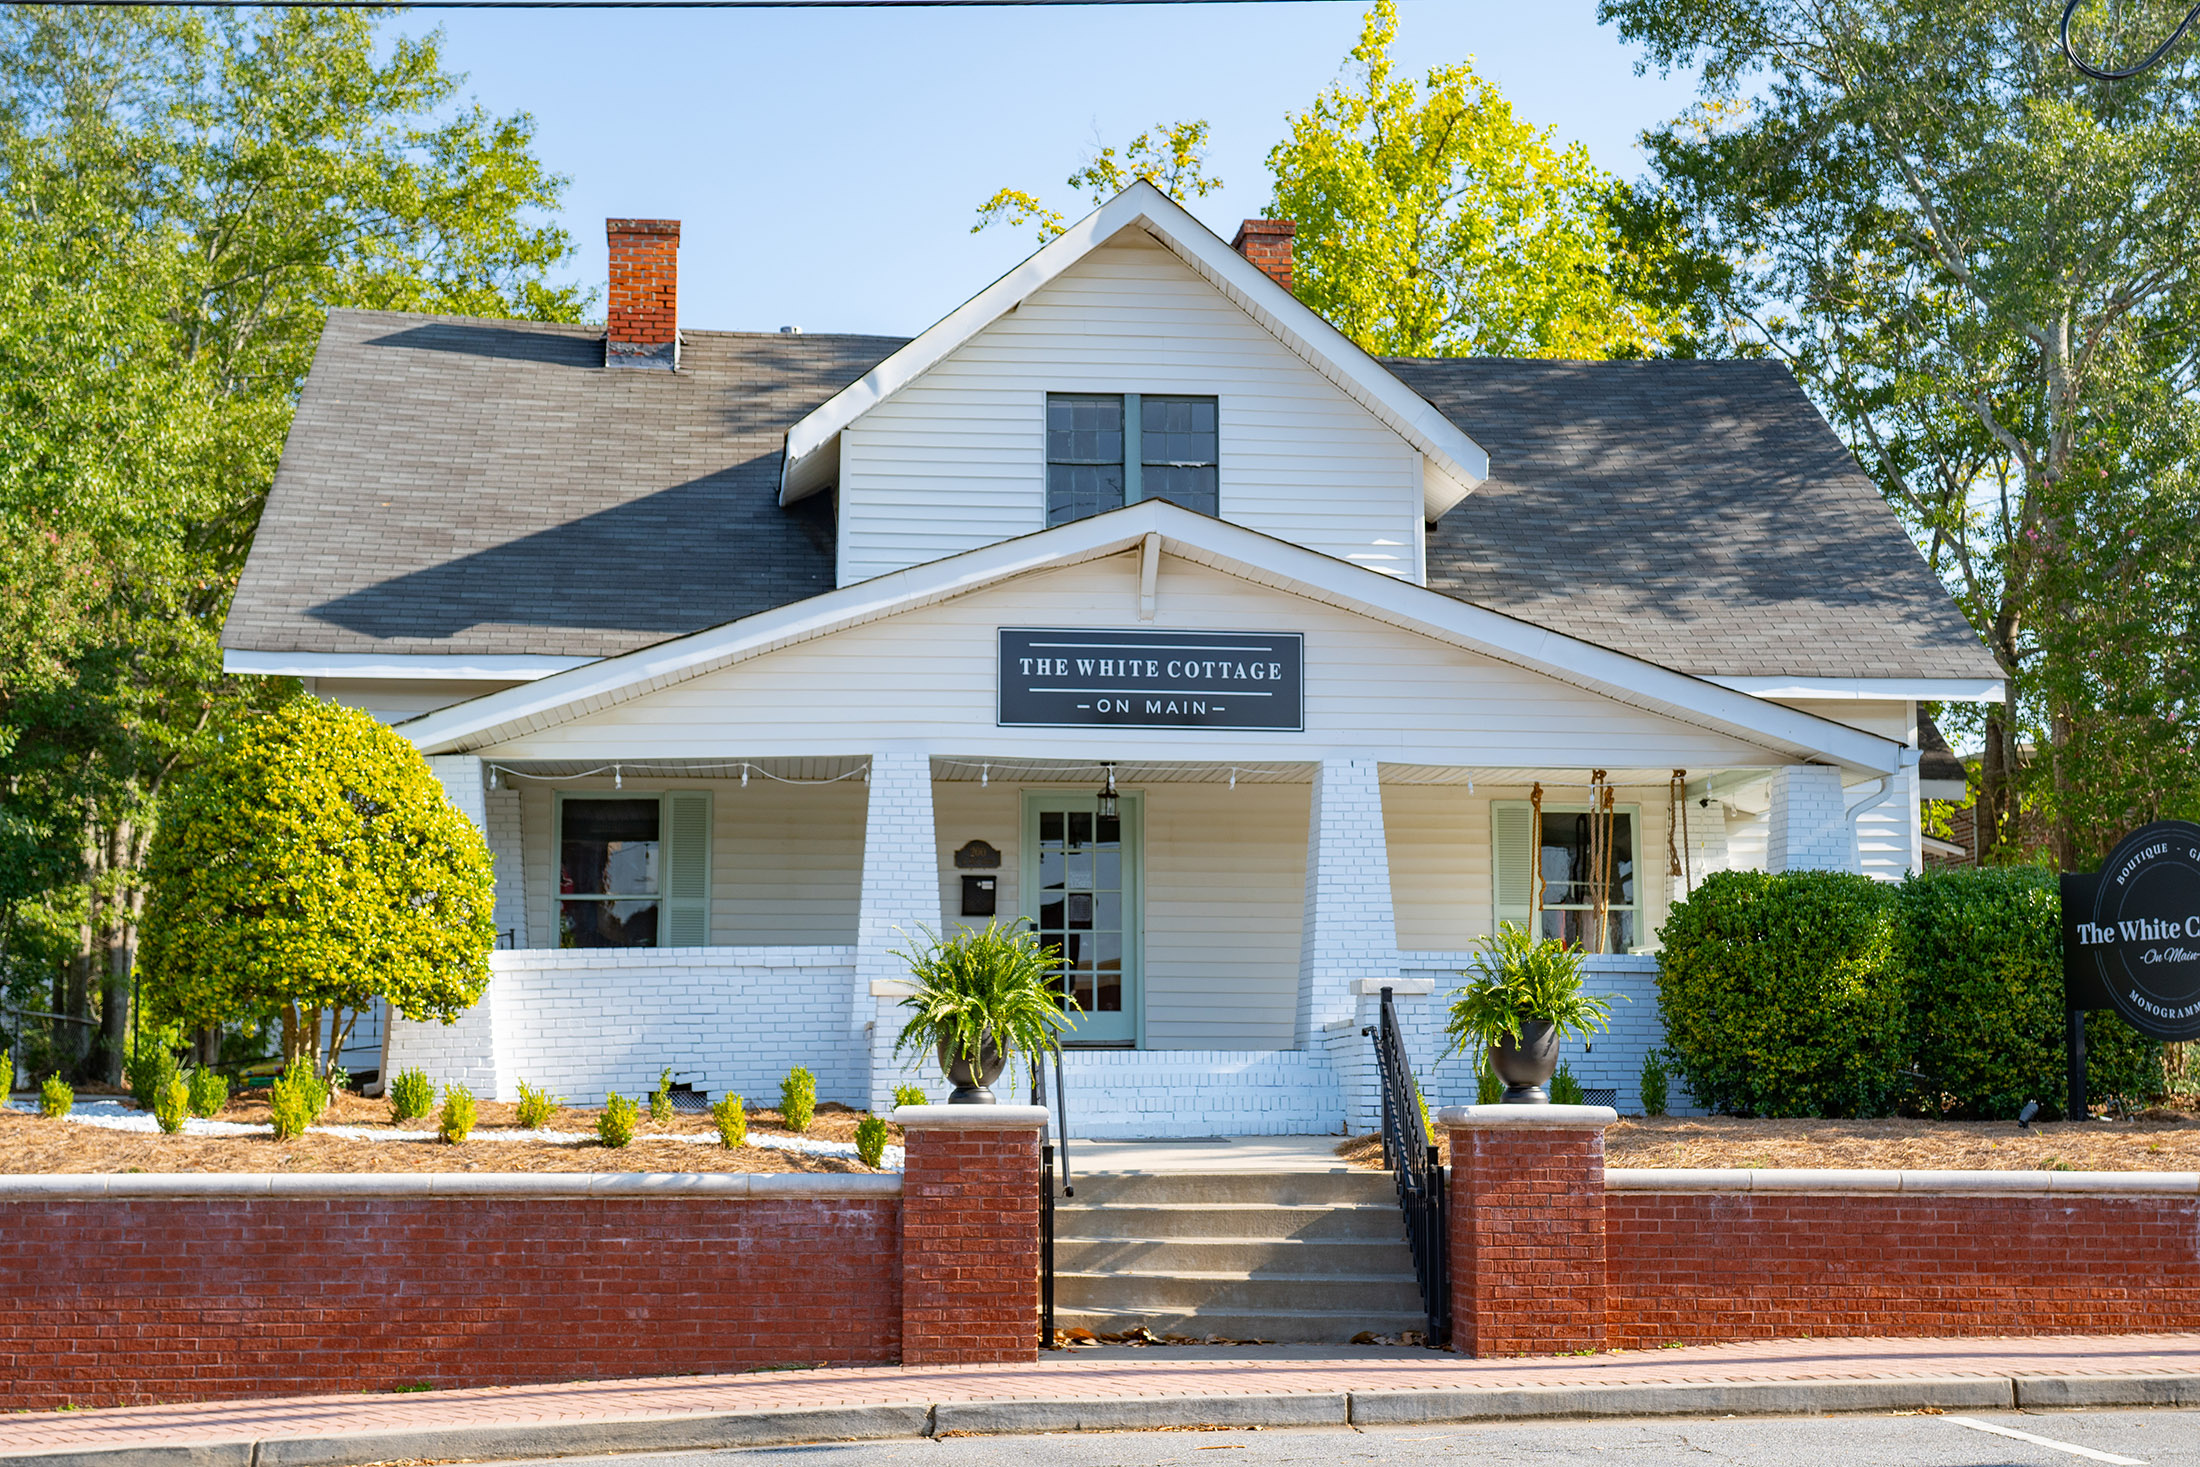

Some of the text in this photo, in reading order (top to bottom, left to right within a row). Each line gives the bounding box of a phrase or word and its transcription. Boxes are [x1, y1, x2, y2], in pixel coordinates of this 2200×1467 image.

[1019, 657, 1282, 680] THE WHITE COTTAGE
[2116, 842, 2168, 886] BOUTIQUE
[2077, 922, 2115, 945] The
[2117, 917, 2181, 942] White
